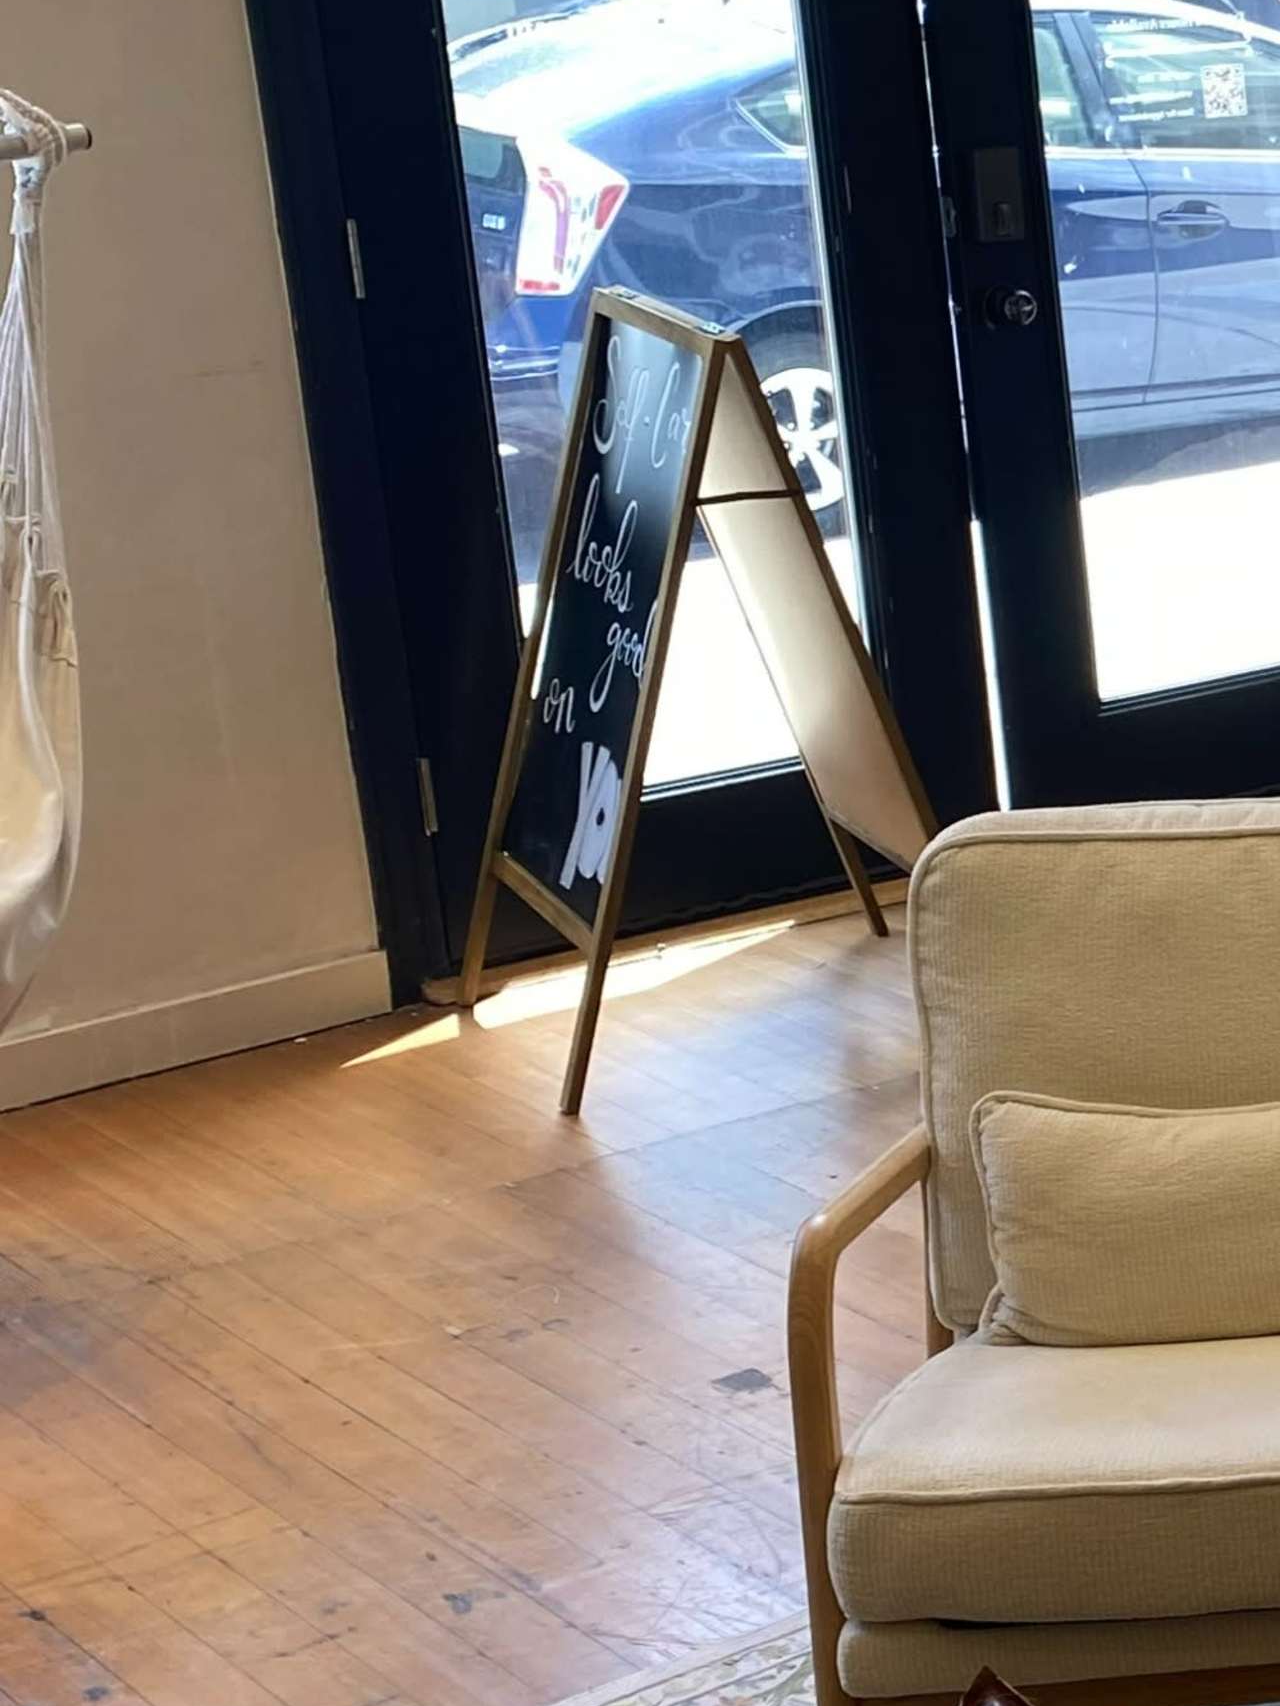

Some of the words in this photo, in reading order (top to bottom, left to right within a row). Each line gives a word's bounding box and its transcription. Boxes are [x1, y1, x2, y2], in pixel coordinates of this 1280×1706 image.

[566, 474, 639, 614] looks
[543, 678, 576, 734] on
[589, 600, 659, 713] good
[559, 741, 623, 890] YO
